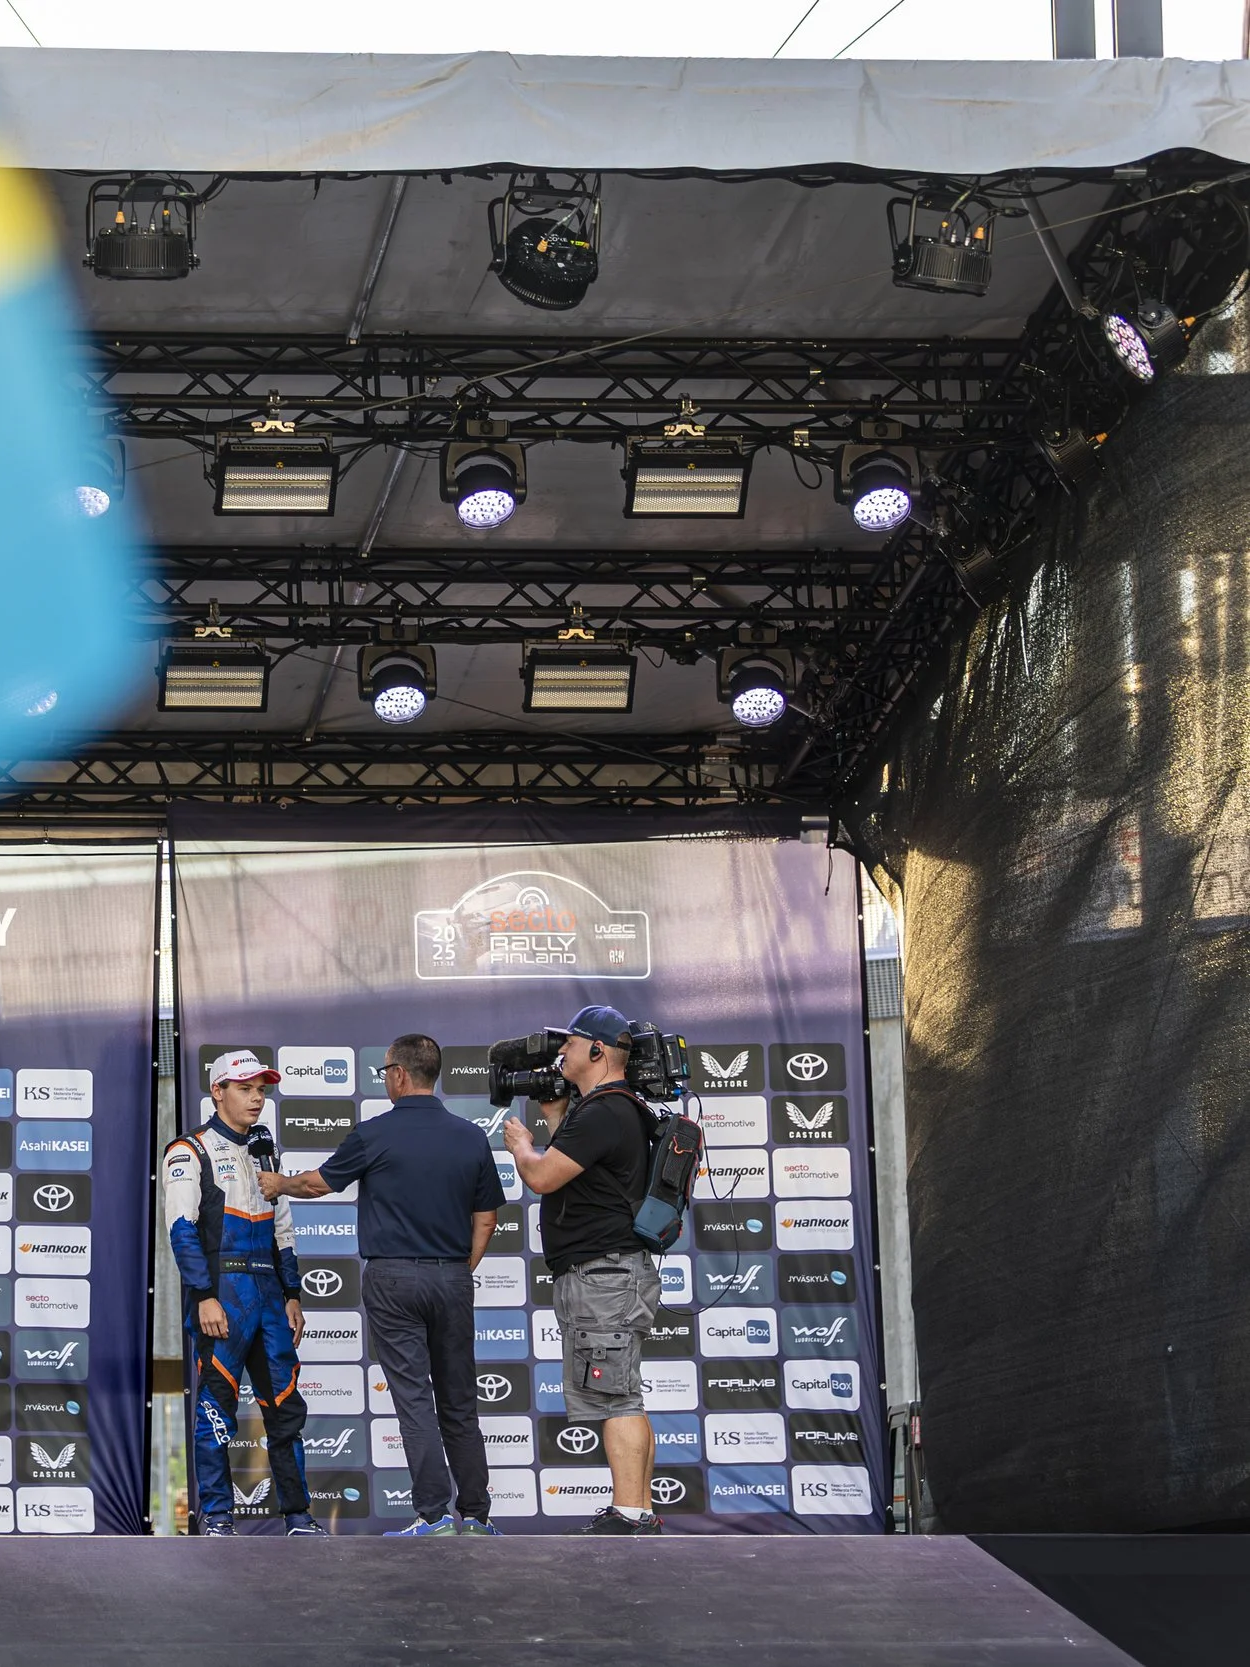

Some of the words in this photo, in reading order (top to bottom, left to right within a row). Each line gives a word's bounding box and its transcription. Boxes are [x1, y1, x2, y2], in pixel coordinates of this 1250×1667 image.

[490, 906, 576, 932] secto
[433, 925, 456, 942] 20
[594, 924, 636, 934] WRC
[433, 944, 456, 961] 25
[704, 1080, 748, 1088] CASTORE
[23, 1086, 51, 1101] KS
[285, 1117, 350, 1126] FORUM8
[705, 1120, 755, 1128] automotive
[789, 1131, 833, 1139] CASTORE
[19, 1139, 90, 1153] AsahiKASEI
[784, 1163, 809, 1172] secto
[789, 1171, 839, 1180] automotive
[294, 1224, 356, 1236] sahiKASEI
[787, 1273, 829, 1283] JYVÄSKYLÄ
[25, 1294, 49, 1302] secto
[30, 1301, 79, 1310] automotive
[475, 1329, 525, 1341] hiKASEI
[790, 1316, 848, 1347] wolf
[23, 1341, 79, 1370] wolf
[708, 1378, 776, 1388] FORUM8
[302, 1389, 352, 1397] automotive
[23, 1402, 65, 1412] JYVÄSKYLÄ
[713, 1431, 741, 1446] KS
[795, 1431, 858, 1441] FORUM8
[32, 1470, 76, 1478] CASTORE
[713, 1483, 786, 1496] AsahiKASEI
[800, 1483, 828, 1498] KS
[24, 1503, 51, 1517] KS
[228, 1507, 270, 1515] ASTORE
